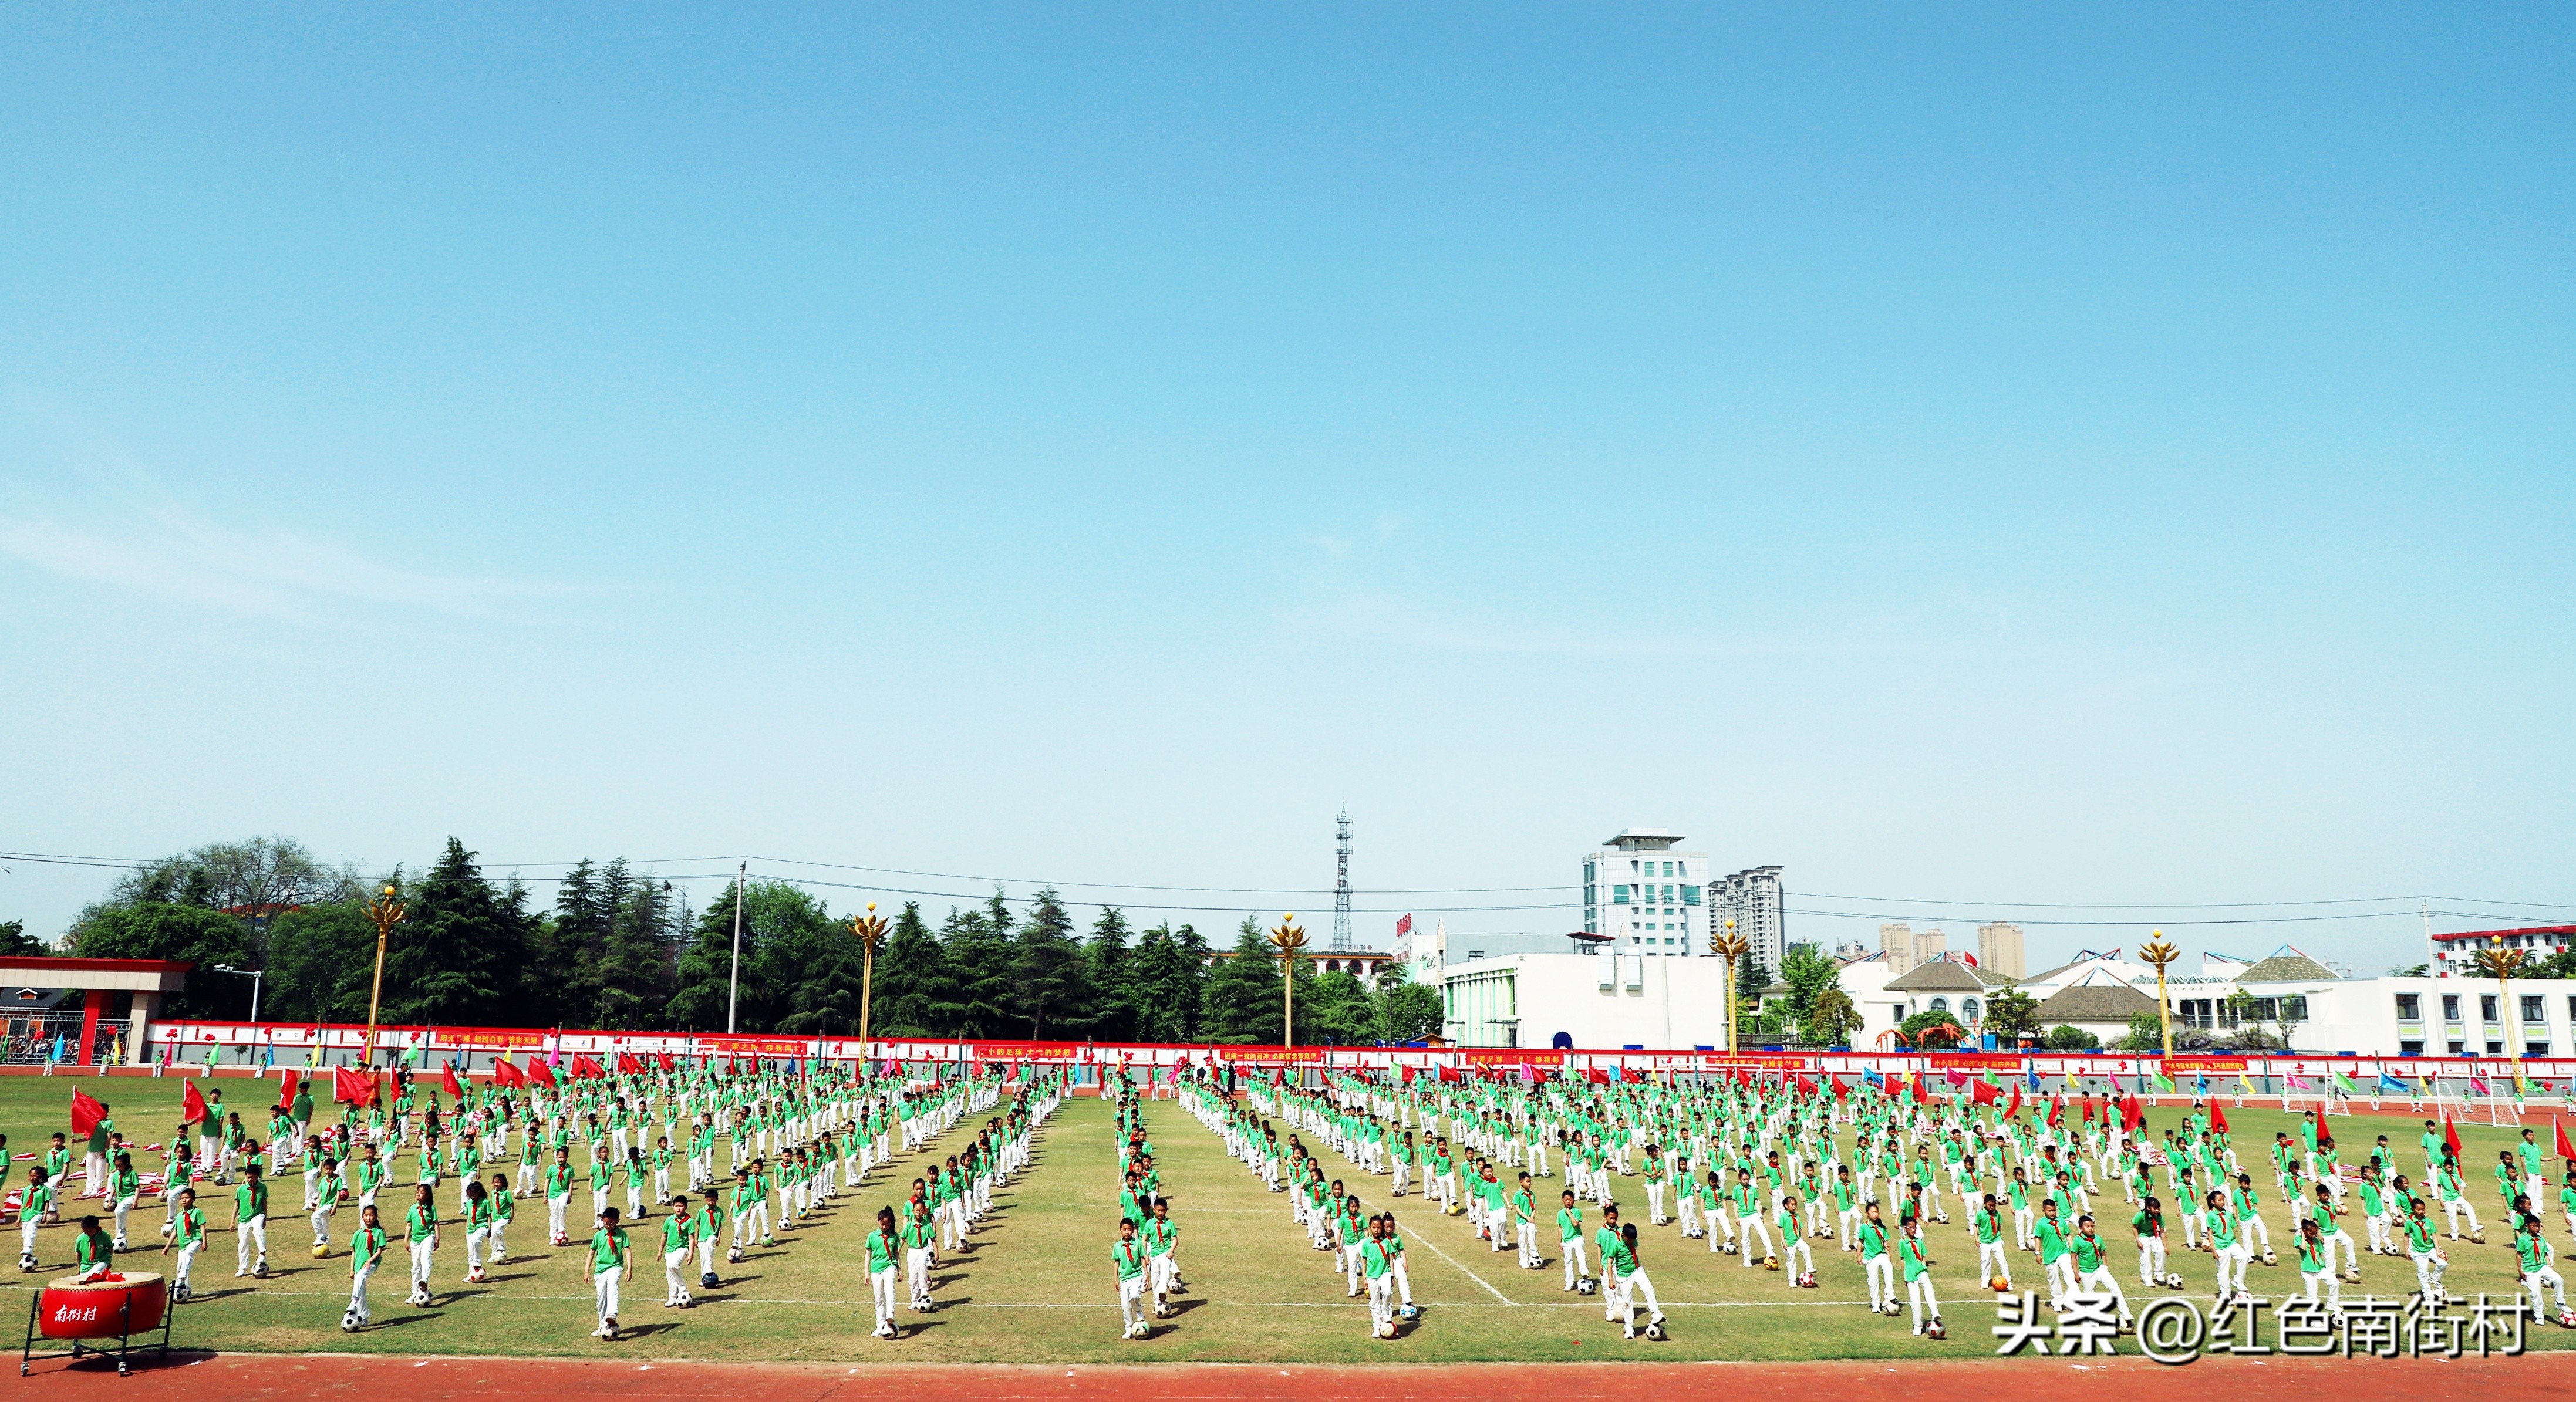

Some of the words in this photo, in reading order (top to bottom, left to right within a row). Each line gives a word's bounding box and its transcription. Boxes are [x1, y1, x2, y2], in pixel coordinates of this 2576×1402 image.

[474, 1035, 504, 1043] 超越自我
[508, 1036, 538, 1045] 精彩无限
[980, 1048, 1023, 1056] 小的足球
[1470, 1055, 1503, 1063] 热爱足球
[54, 1304, 97, 1323] 南街村
